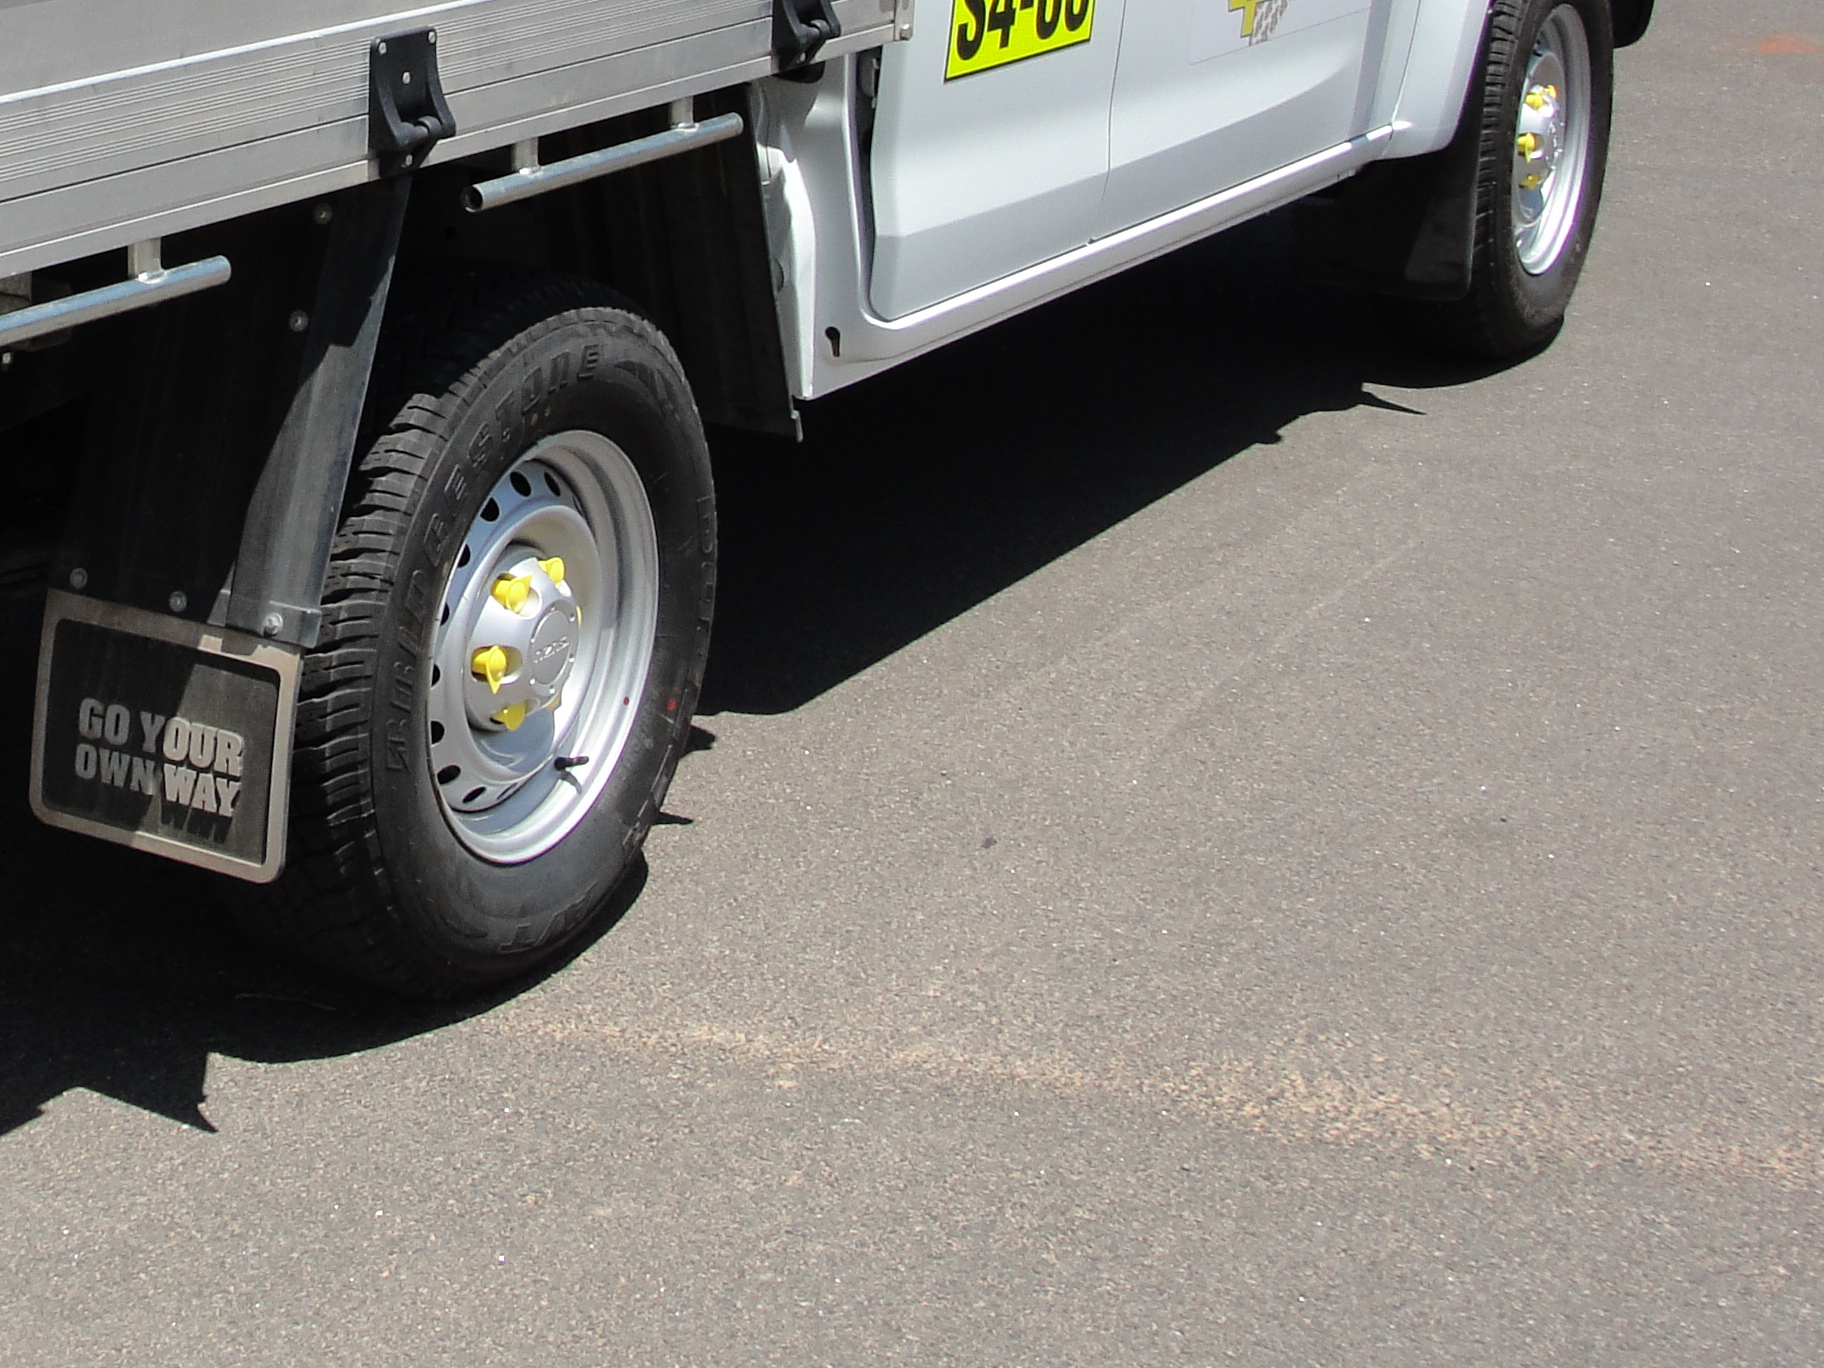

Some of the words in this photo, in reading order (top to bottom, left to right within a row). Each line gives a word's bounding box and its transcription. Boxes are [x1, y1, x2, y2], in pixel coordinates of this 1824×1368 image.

[78, 697, 130, 746] GO
[139, 711, 245, 777] YOUR
[75, 743, 156, 796] OWN
[163, 763, 242, 817] WAY
